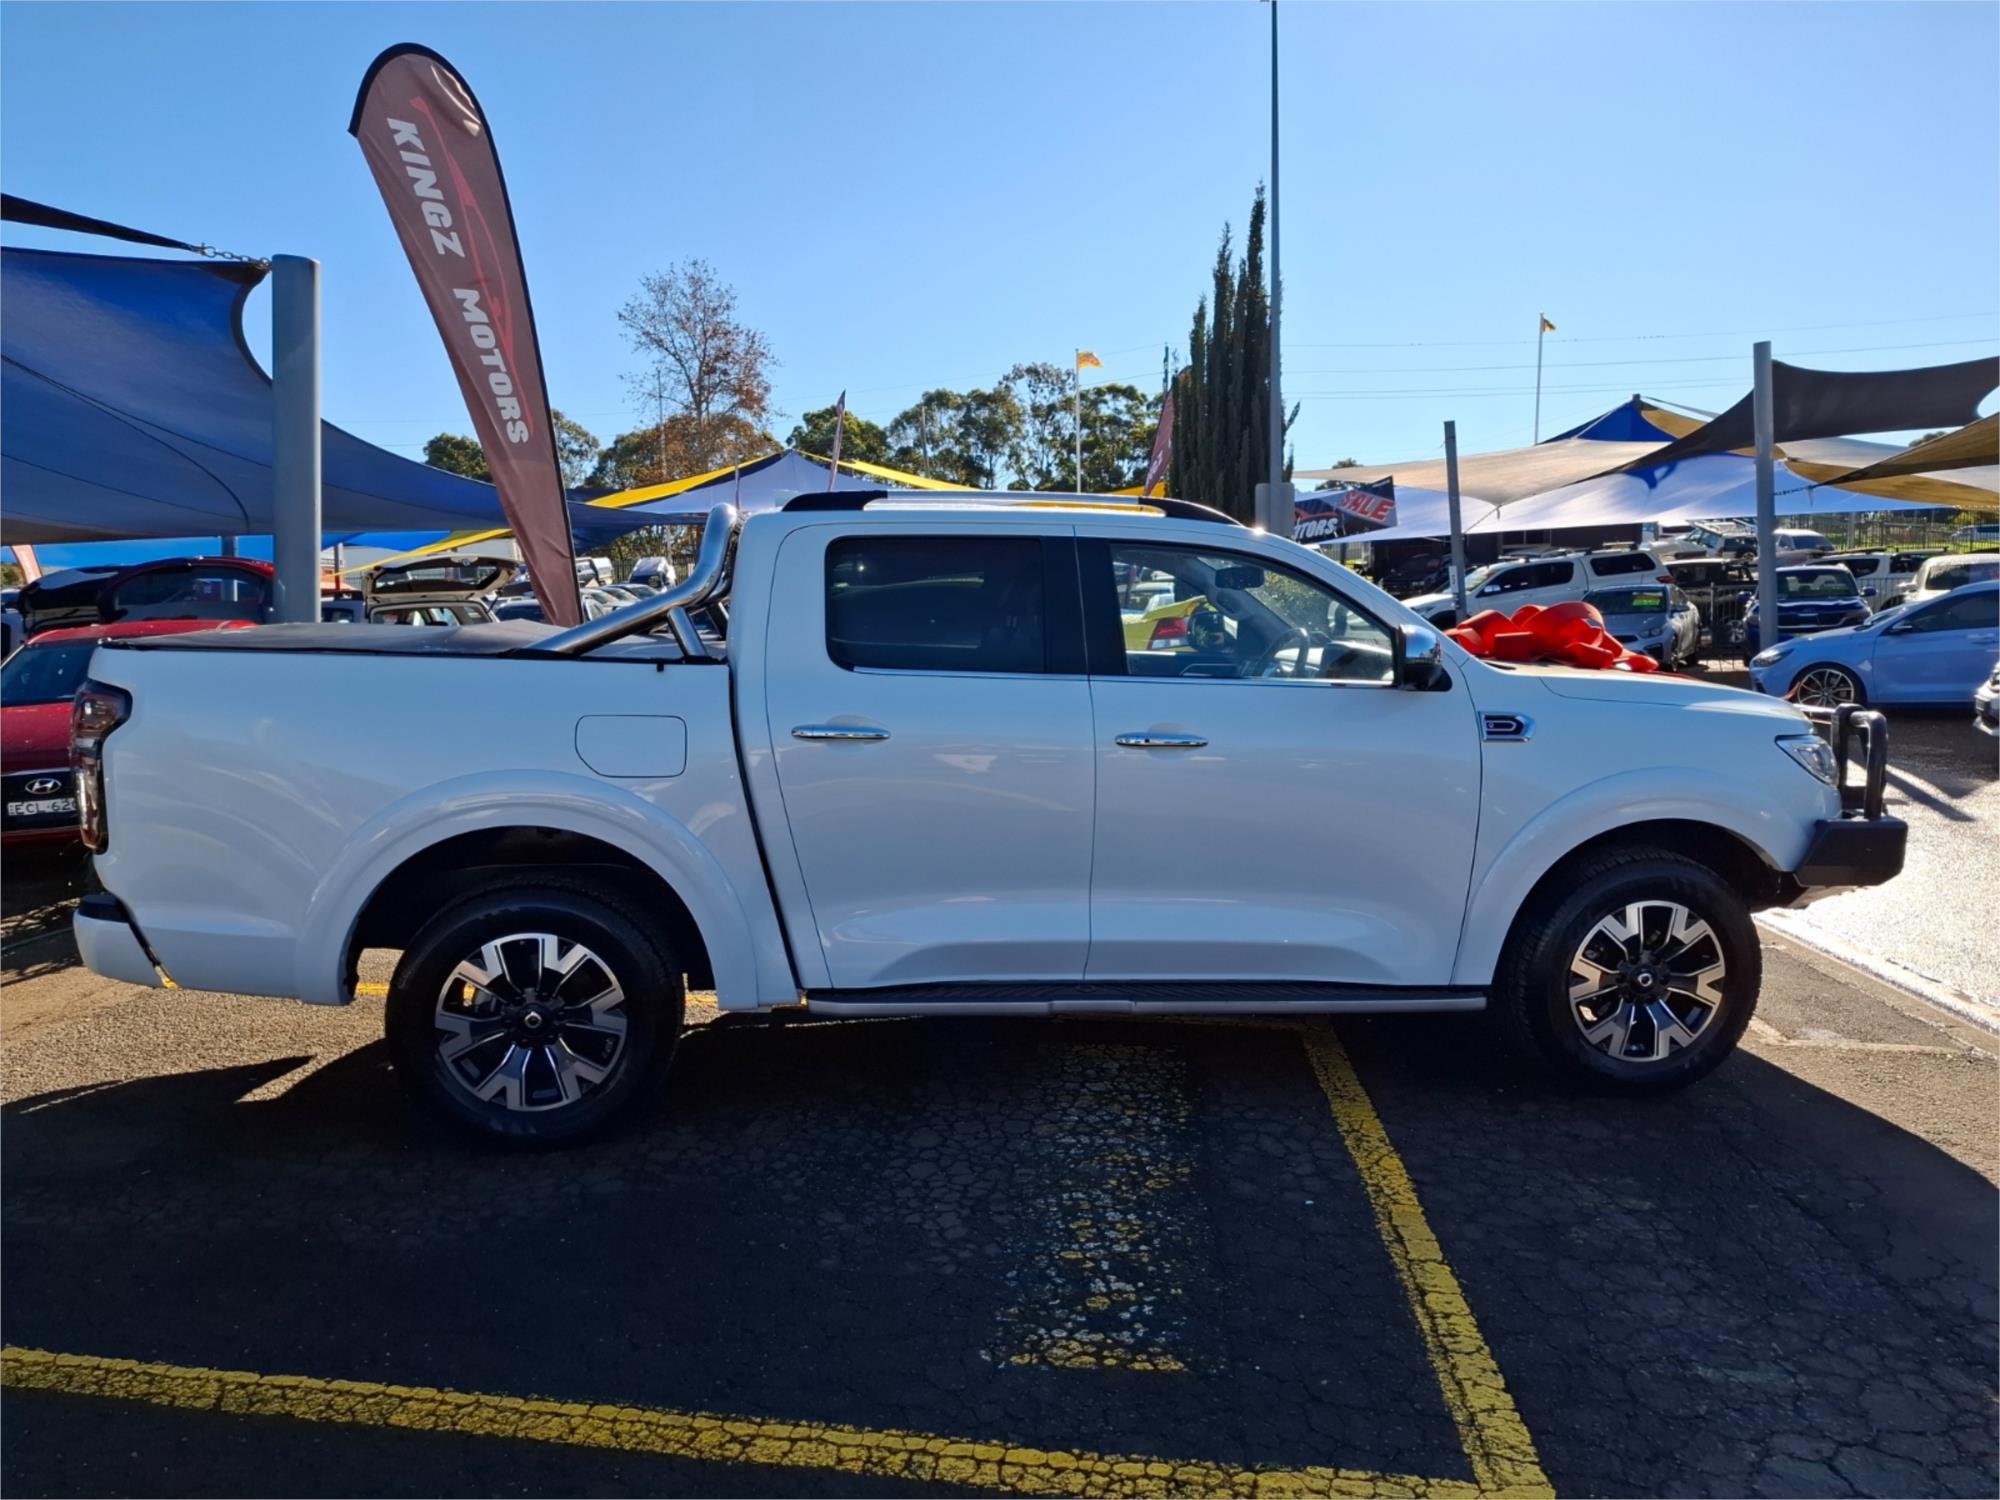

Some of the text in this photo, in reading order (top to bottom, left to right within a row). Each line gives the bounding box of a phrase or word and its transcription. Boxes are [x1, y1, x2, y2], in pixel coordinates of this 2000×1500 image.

[387, 117, 530, 444] KINGZ MOTORS
[1341, 489, 1394, 521] SALE
